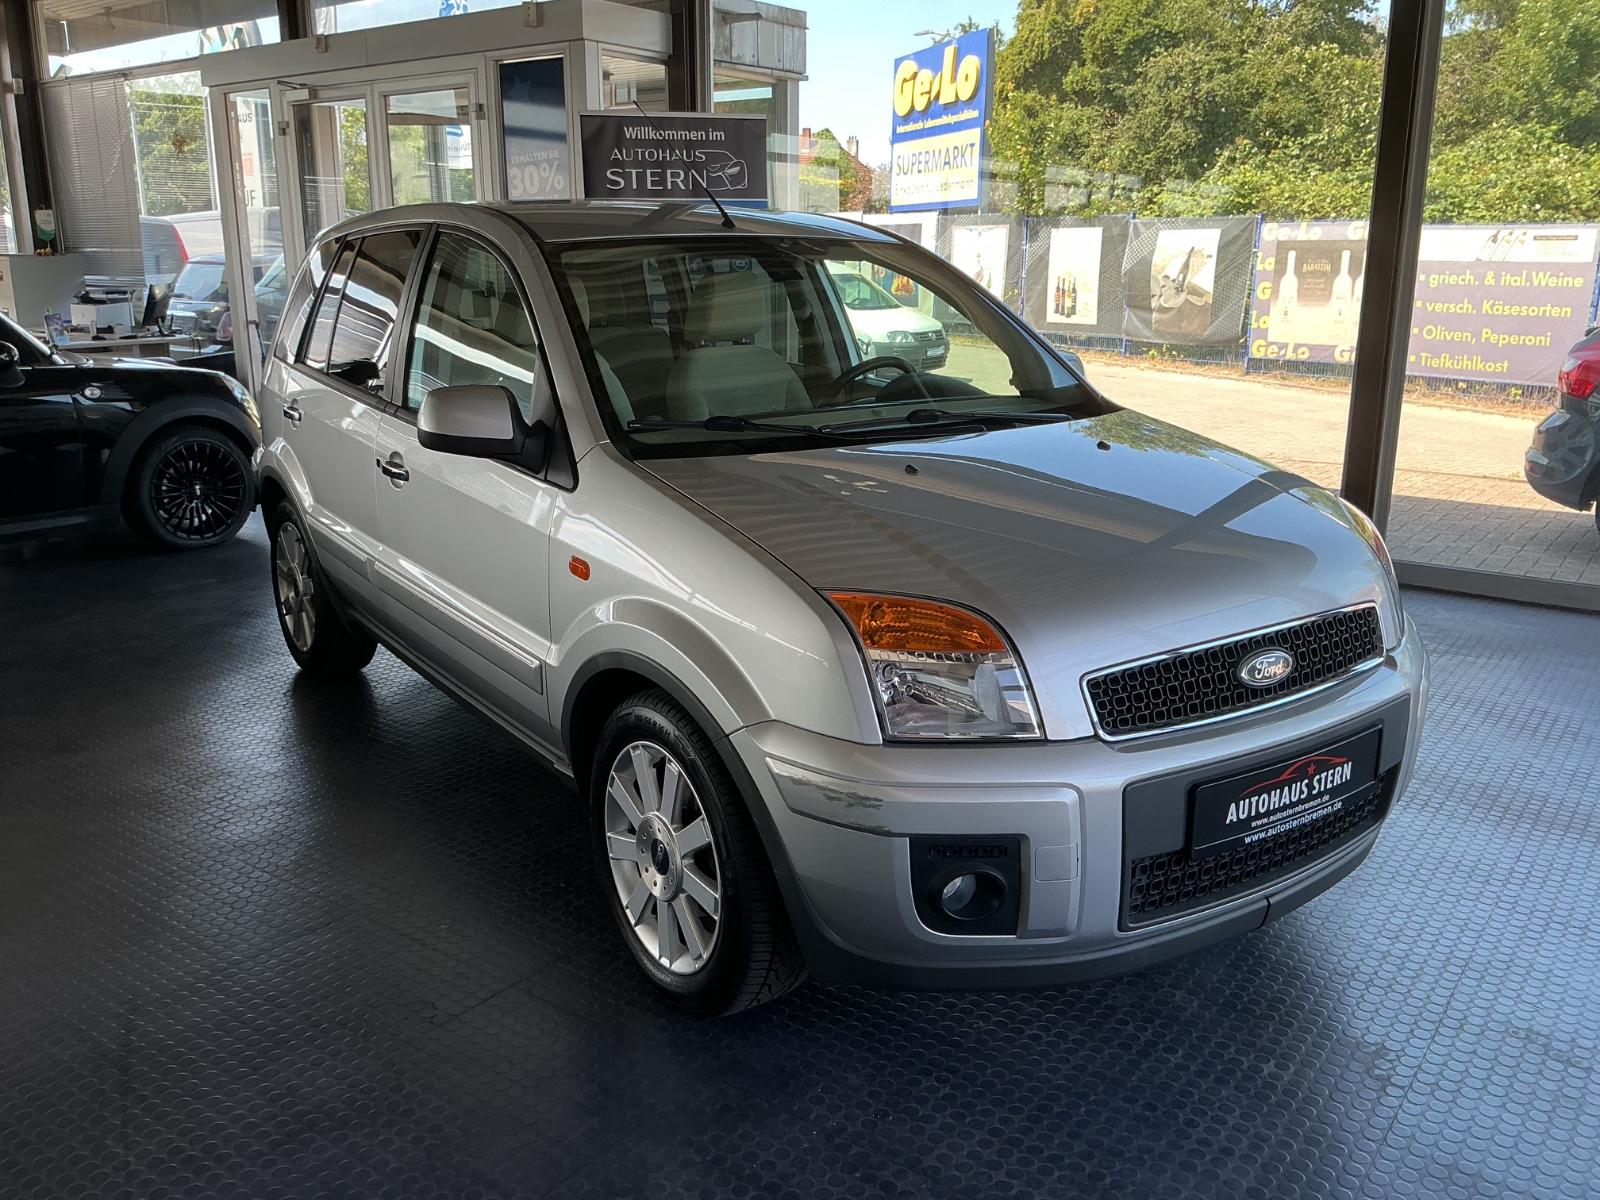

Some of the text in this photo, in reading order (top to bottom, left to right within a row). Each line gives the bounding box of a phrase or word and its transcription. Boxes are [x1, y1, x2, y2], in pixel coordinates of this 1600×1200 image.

[624, 126, 725, 141] Willkommen im
[610, 148, 706, 162] AUTOHAUS
[895, 142, 976, 177] SUPERMARKT
[510, 160, 564, 197] 30%
[606, 168, 707, 190] STERN
[1429, 270, 1479, 288] griech.
[1484, 271, 1496, 286] &
[1426, 298, 1572, 318] versch. Käsesorten
[1422, 325, 1552, 347] Oliven, Peperoni
[1419, 352, 1509, 373] Tiefkühlkost
[1254, 657, 1284, 680] Ford
[1225, 761, 1352, 825] AUTOHAUS STERN
[1244, 801, 1343, 844] www.autosternbremen.de
